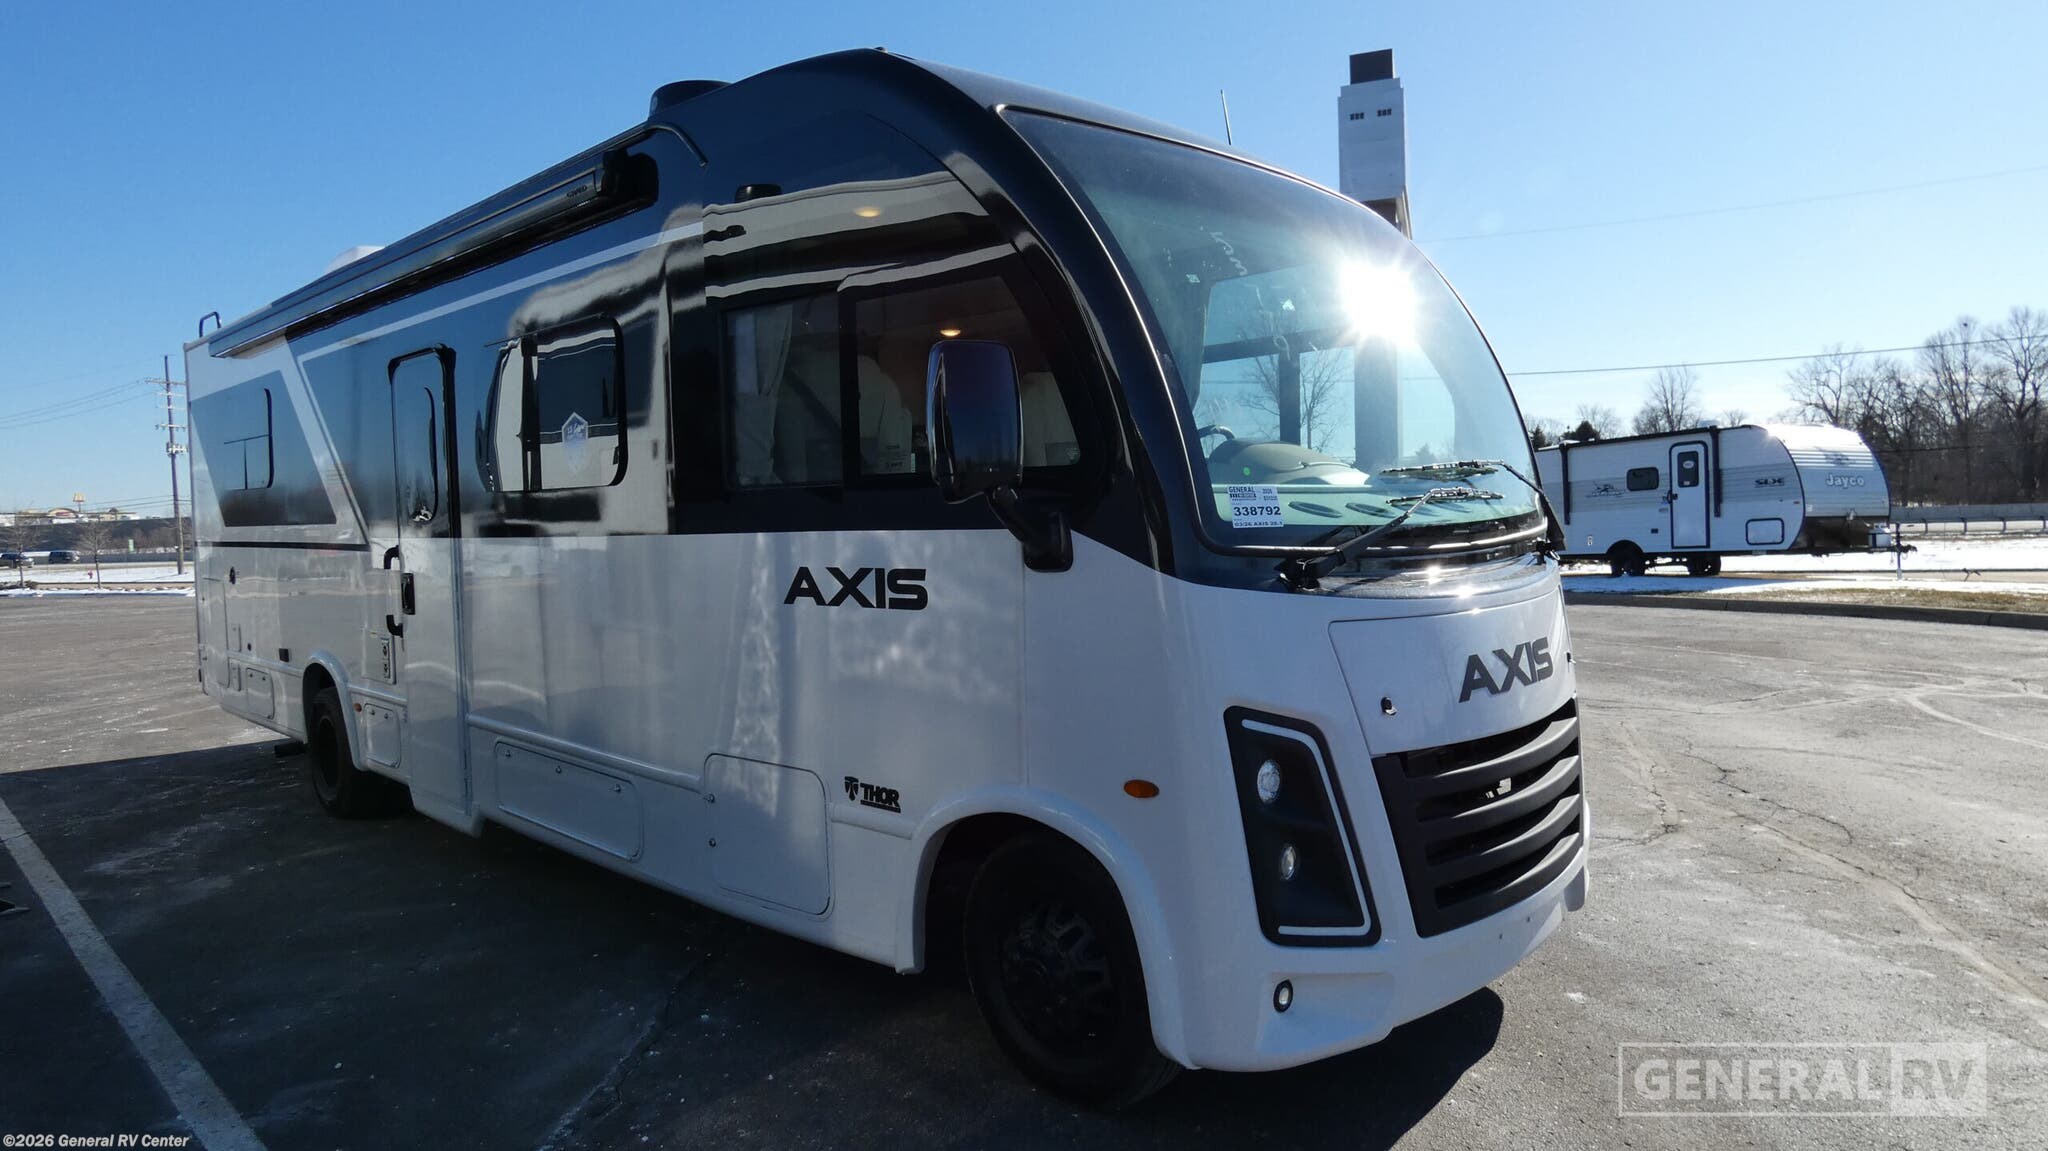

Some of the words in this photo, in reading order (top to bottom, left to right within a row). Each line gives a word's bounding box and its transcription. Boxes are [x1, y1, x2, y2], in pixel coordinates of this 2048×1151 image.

[1825, 472, 1865, 489] Jayco
[1233, 506, 1281, 516] 338792
[783, 566, 929, 611] AXIS
[1458, 636, 1554, 704] AXIS
[860, 782, 901, 808] THOR
